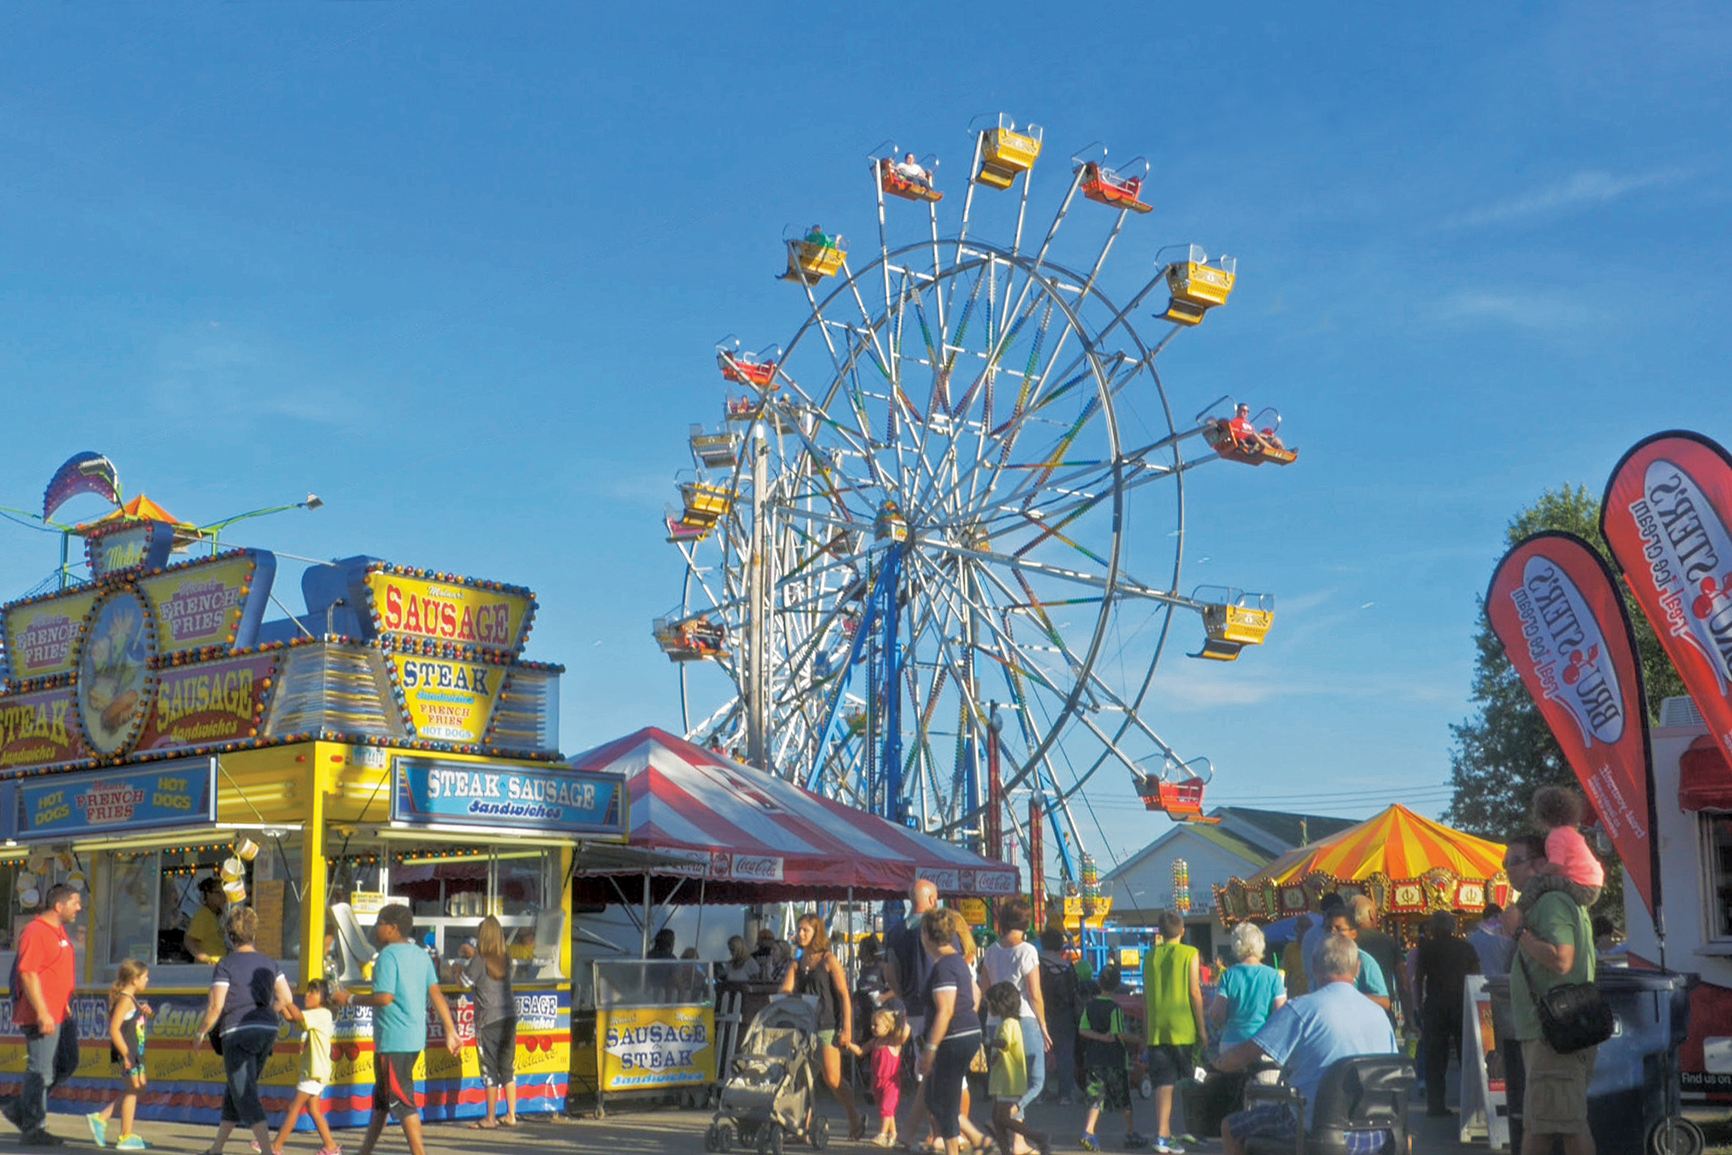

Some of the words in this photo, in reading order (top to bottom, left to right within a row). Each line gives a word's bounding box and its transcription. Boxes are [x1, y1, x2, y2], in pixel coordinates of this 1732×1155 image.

[160, 587, 240, 622] FRENCH
[385, 584, 510, 645] SAUSAGE
[170, 610, 224, 635] FRIES
[16, 622, 82, 650] FRENCH
[25, 641, 70, 663] FRIES
[403, 660, 489, 696] STEAK
[157, 668, 254, 734] SAUSAGE
[420, 704, 471, 717] FRENCH
[170, 718, 238, 742] Sandwiches
[428, 715, 462, 726] FRIES
[422, 727, 442, 736] HOT
[445, 728, 472, 739] DOGS
[158, 777, 187, 792] HOT
[427, 769, 500, 798] STEAK
[508, 776, 596, 811] SAUSAGE
[38, 791, 64, 810] HOT
[75, 790, 145, 809] FRENCH
[153, 793, 190, 810] DOGS
[468, 799, 562, 819] Sandwiches
[35, 804, 69, 826] DOGS
[86, 804, 133, 821] FRIES
[606, 1024, 706, 1048] SAUSAGE
[621, 1050, 694, 1070] STEAK
[612, 1072, 704, 1087] Sandwiches
[1681, 1072, 1702, 1084] Find
[1705, 1075, 1716, 1085] us
[1718, 1075, 1731, 1085] on
